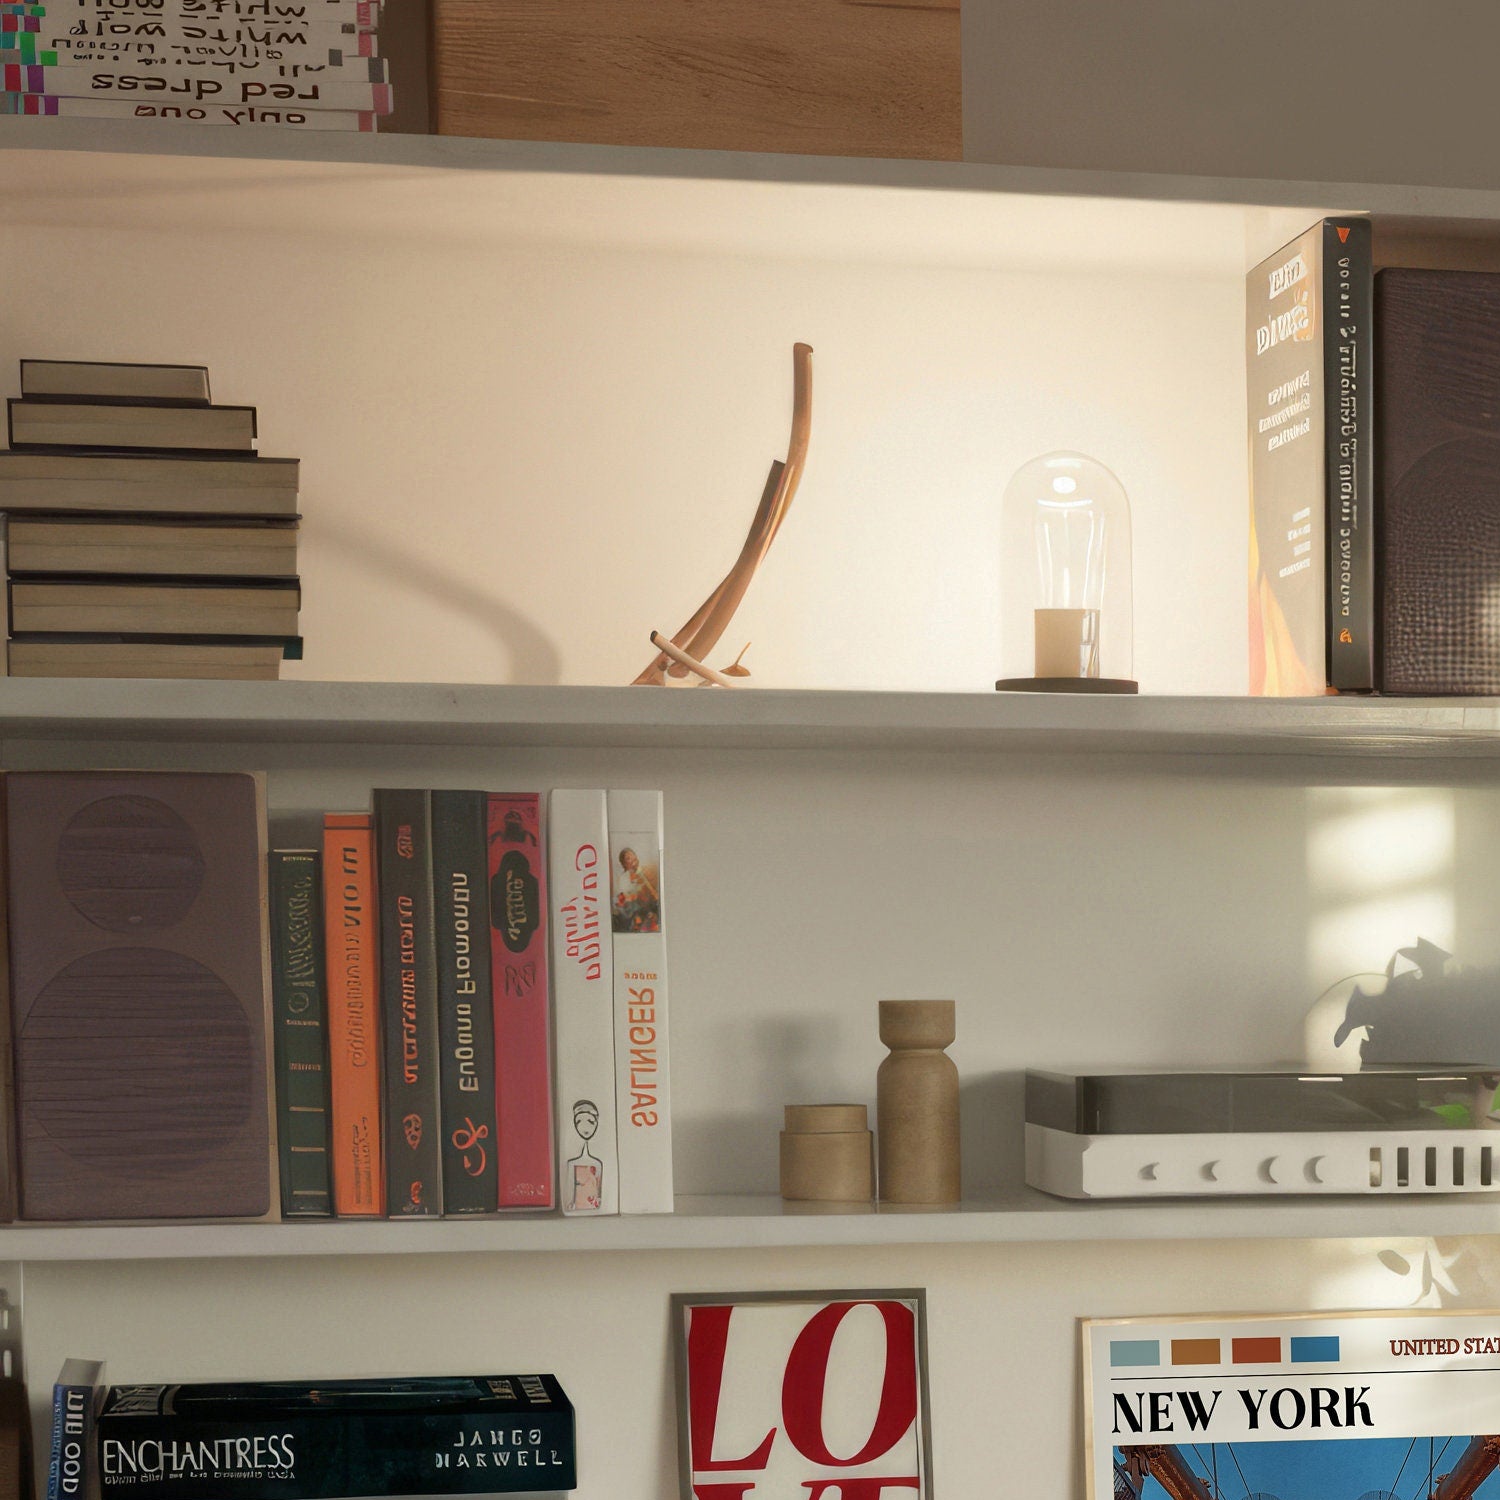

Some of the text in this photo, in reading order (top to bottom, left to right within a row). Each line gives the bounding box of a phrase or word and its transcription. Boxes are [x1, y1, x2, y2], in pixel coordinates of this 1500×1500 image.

[241, 82, 320, 102] red
[1389, 1338, 1461, 1357] UNITED
[1112, 1386, 1374, 1433] NEW YORK
[103, 1433, 295, 1475] ENCHANTRESS
